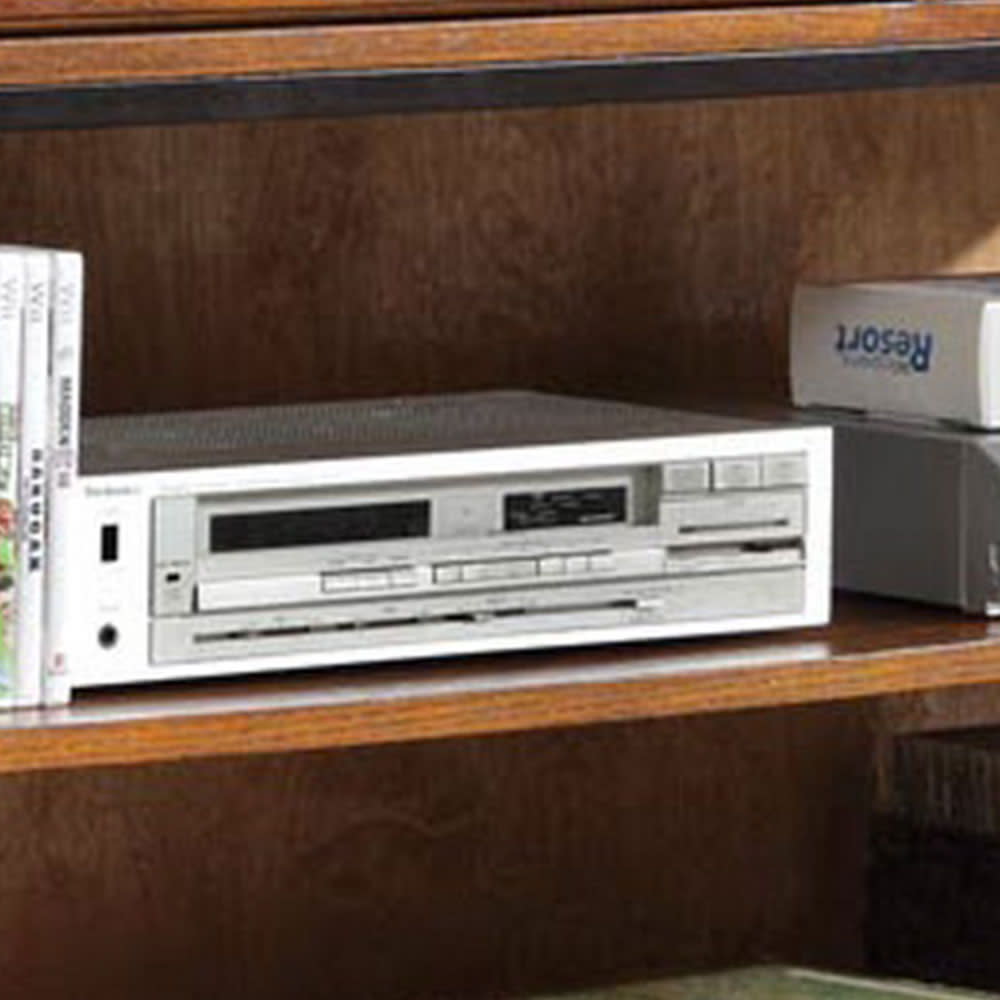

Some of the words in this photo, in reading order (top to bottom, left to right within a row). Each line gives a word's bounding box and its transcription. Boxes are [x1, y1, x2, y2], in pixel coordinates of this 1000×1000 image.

[1, 277, 17, 319] Wii
[31, 282, 45, 323] Wii
[836, 324, 932, 373] Resort
[58, 377, 72, 446] MADDEN
